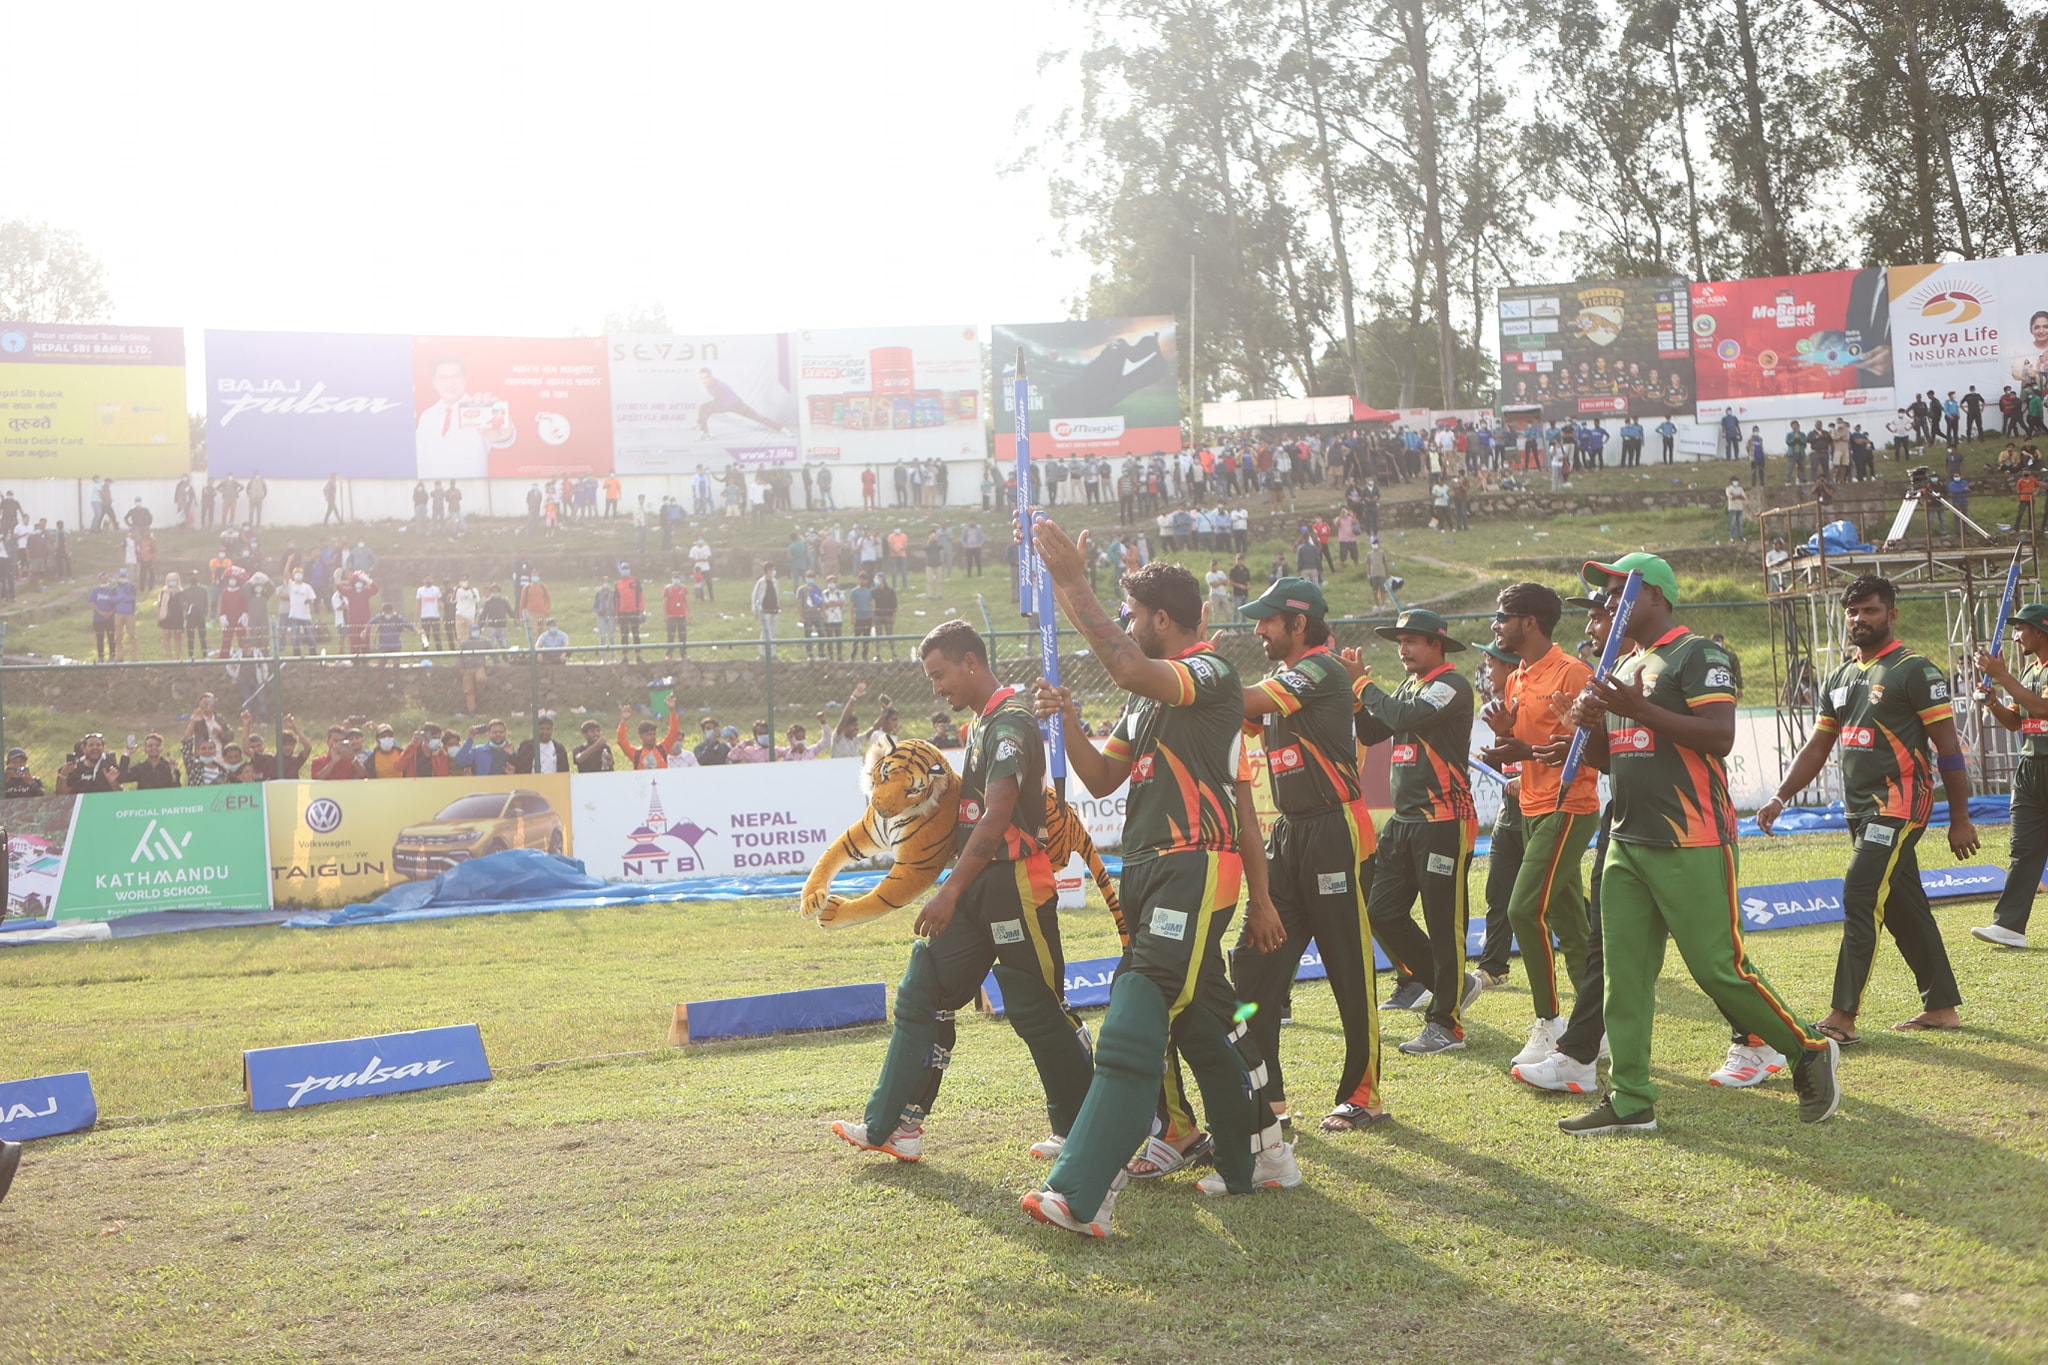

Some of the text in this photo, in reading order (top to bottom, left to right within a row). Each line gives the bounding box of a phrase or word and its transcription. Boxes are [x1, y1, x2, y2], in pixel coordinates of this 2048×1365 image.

[1581, 296, 1623, 309] TIGERS
[1752, 301, 1816, 319] MoBank
[1908, 326, 1999, 348] Surya Life
[32, 344, 70, 353] NEPAL
[73, 344, 91, 353] SBI
[94, 344, 126, 354] BANK
[1908, 344, 2000, 362] INSURANCE
[218, 378, 300, 393] BAJAJ
[219, 380, 402, 428] pulsar
[1284, 754, 1295, 762] PAY
[115, 804, 204, 819] OFFICIAL PARTNER
[225, 795, 260, 812] EPL
[730, 811, 798, 828] NEPAL
[298, 838, 351, 849] Volkswagen
[731, 829, 828, 848] TOURISM
[623, 856, 695, 877] NTB
[733, 850, 806, 868] BOARD
[96, 865, 229, 889] KATHMANDU
[271, 862, 385, 880] TAIGUN
[115, 884, 212, 902] WORLD SCHOOL
[1773, 895, 1840, 916] BAJAJ
[1003, 928, 1020, 939] JIMI
[1160, 922, 1183, 933] JIMI
[287, 1055, 456, 1109] pulsar
